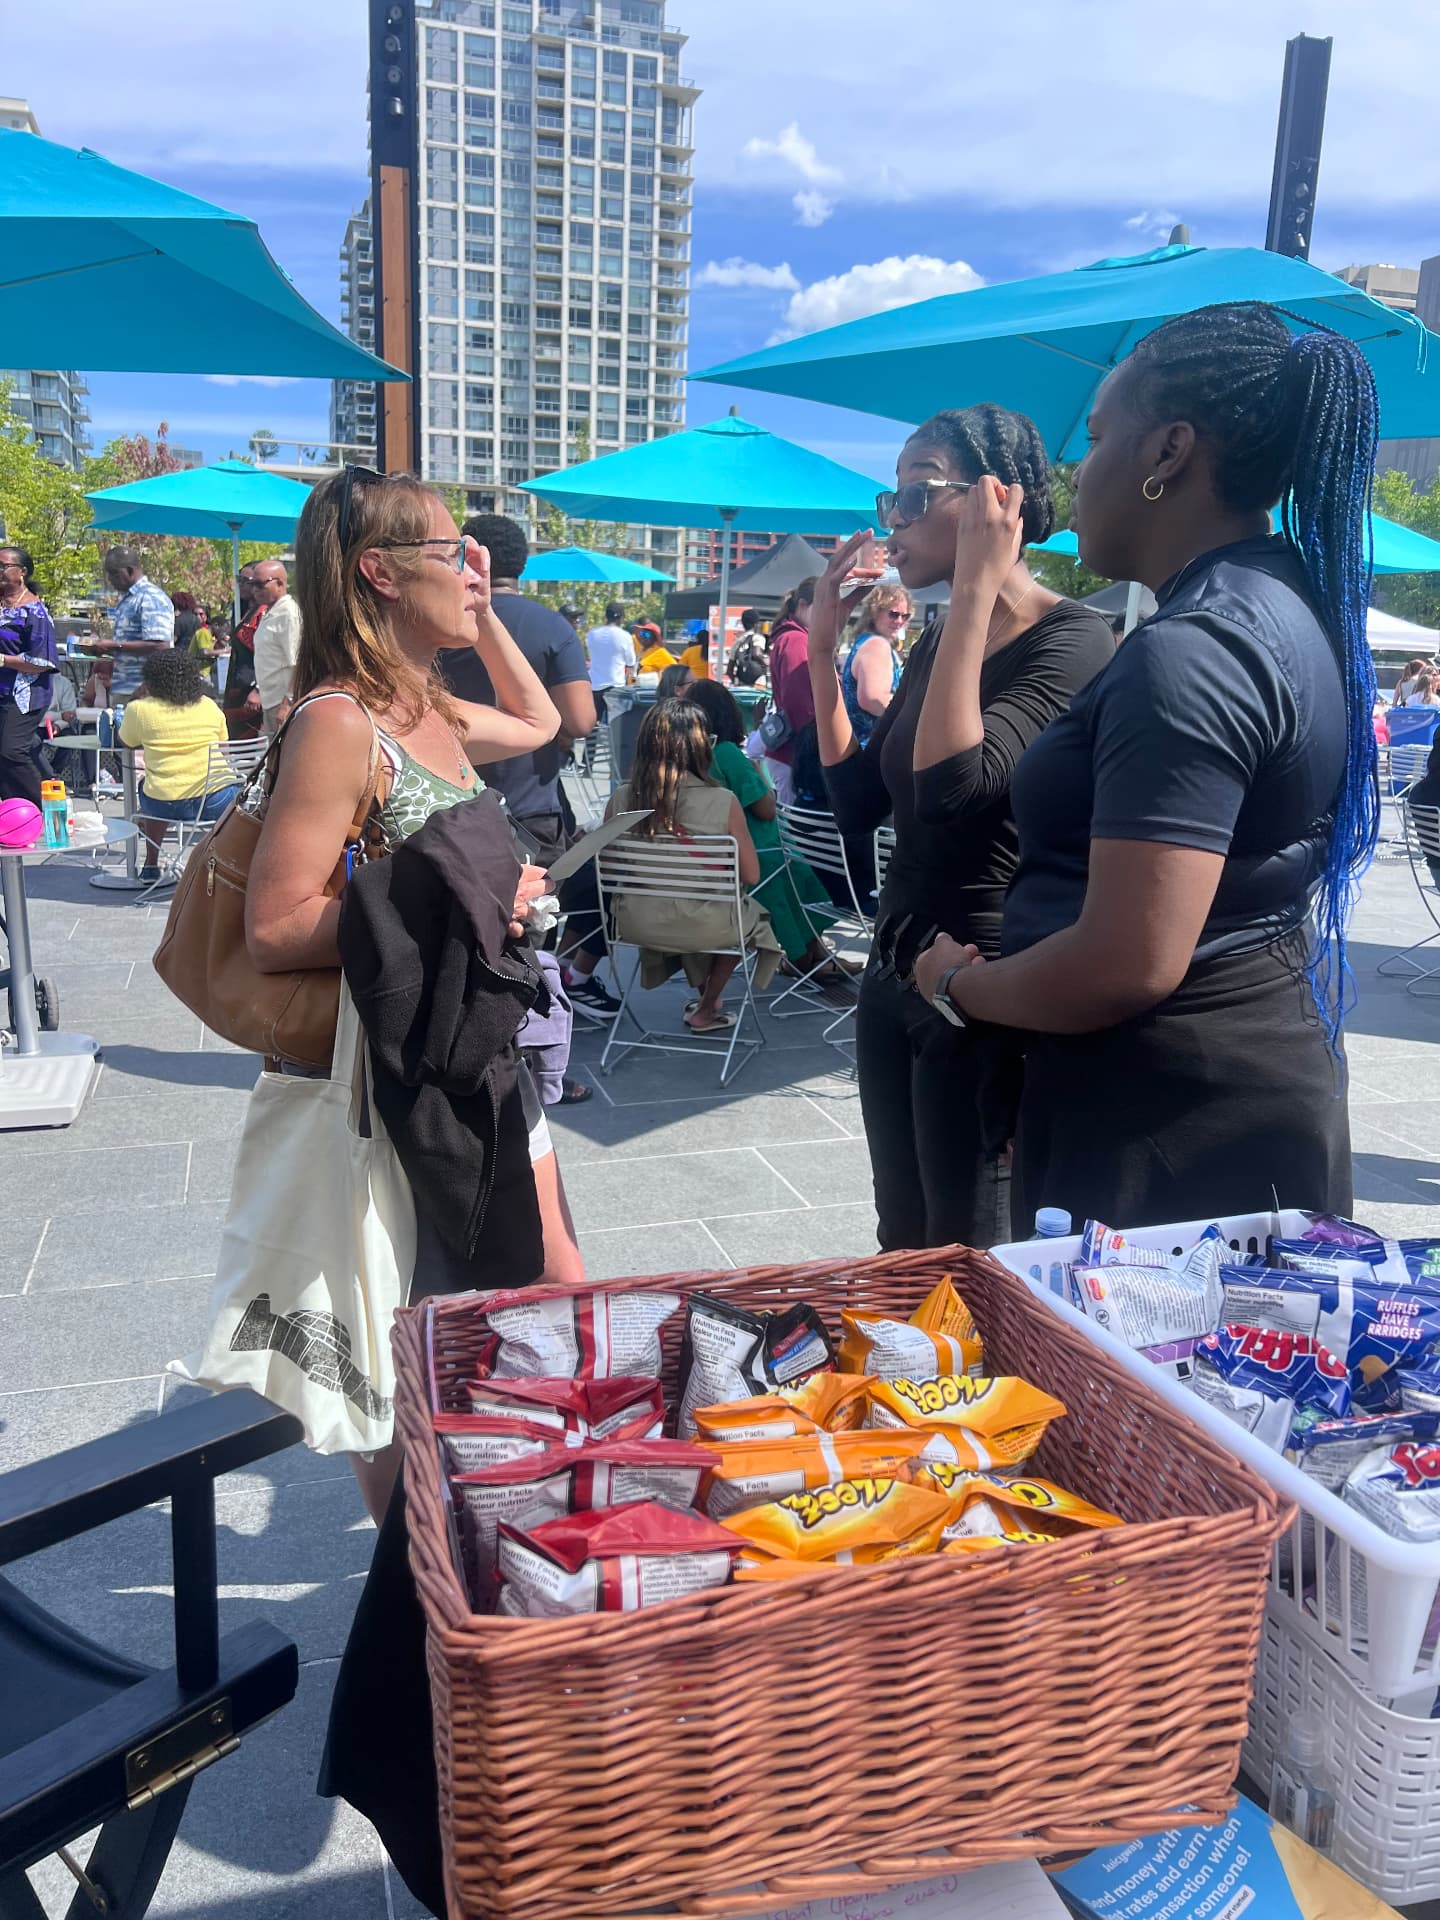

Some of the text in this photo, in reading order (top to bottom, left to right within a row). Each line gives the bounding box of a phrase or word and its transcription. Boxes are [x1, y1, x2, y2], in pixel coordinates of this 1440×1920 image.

[1228, 1289, 1283, 1300] Nutrition Facts
[1376, 1301, 1421, 1316] RUFFLES
[1380, 1313, 1410, 1327] HAVE
[693, 1326, 713, 1340] Valeur
[695, 1318, 736, 1338] Nutrition Facts
[1367, 1323, 1423, 1340] RRRIDGES
[744, 1429, 765, 1438] Facts
[485, 1441, 508, 1450] Facts
[467, 1487, 533, 1500] Nutrition Facts
[1208, 1817, 1242, 1864] when
[1114, 1862, 1158, 1898] money
[1152, 1828, 1183, 1865] with
[1127, 1889, 1159, 1917] rates
[1155, 1865, 1182, 1893] and
[1178, 1832, 1207, 1870] earn
[1194, 1845, 1252, 1919] someone!
